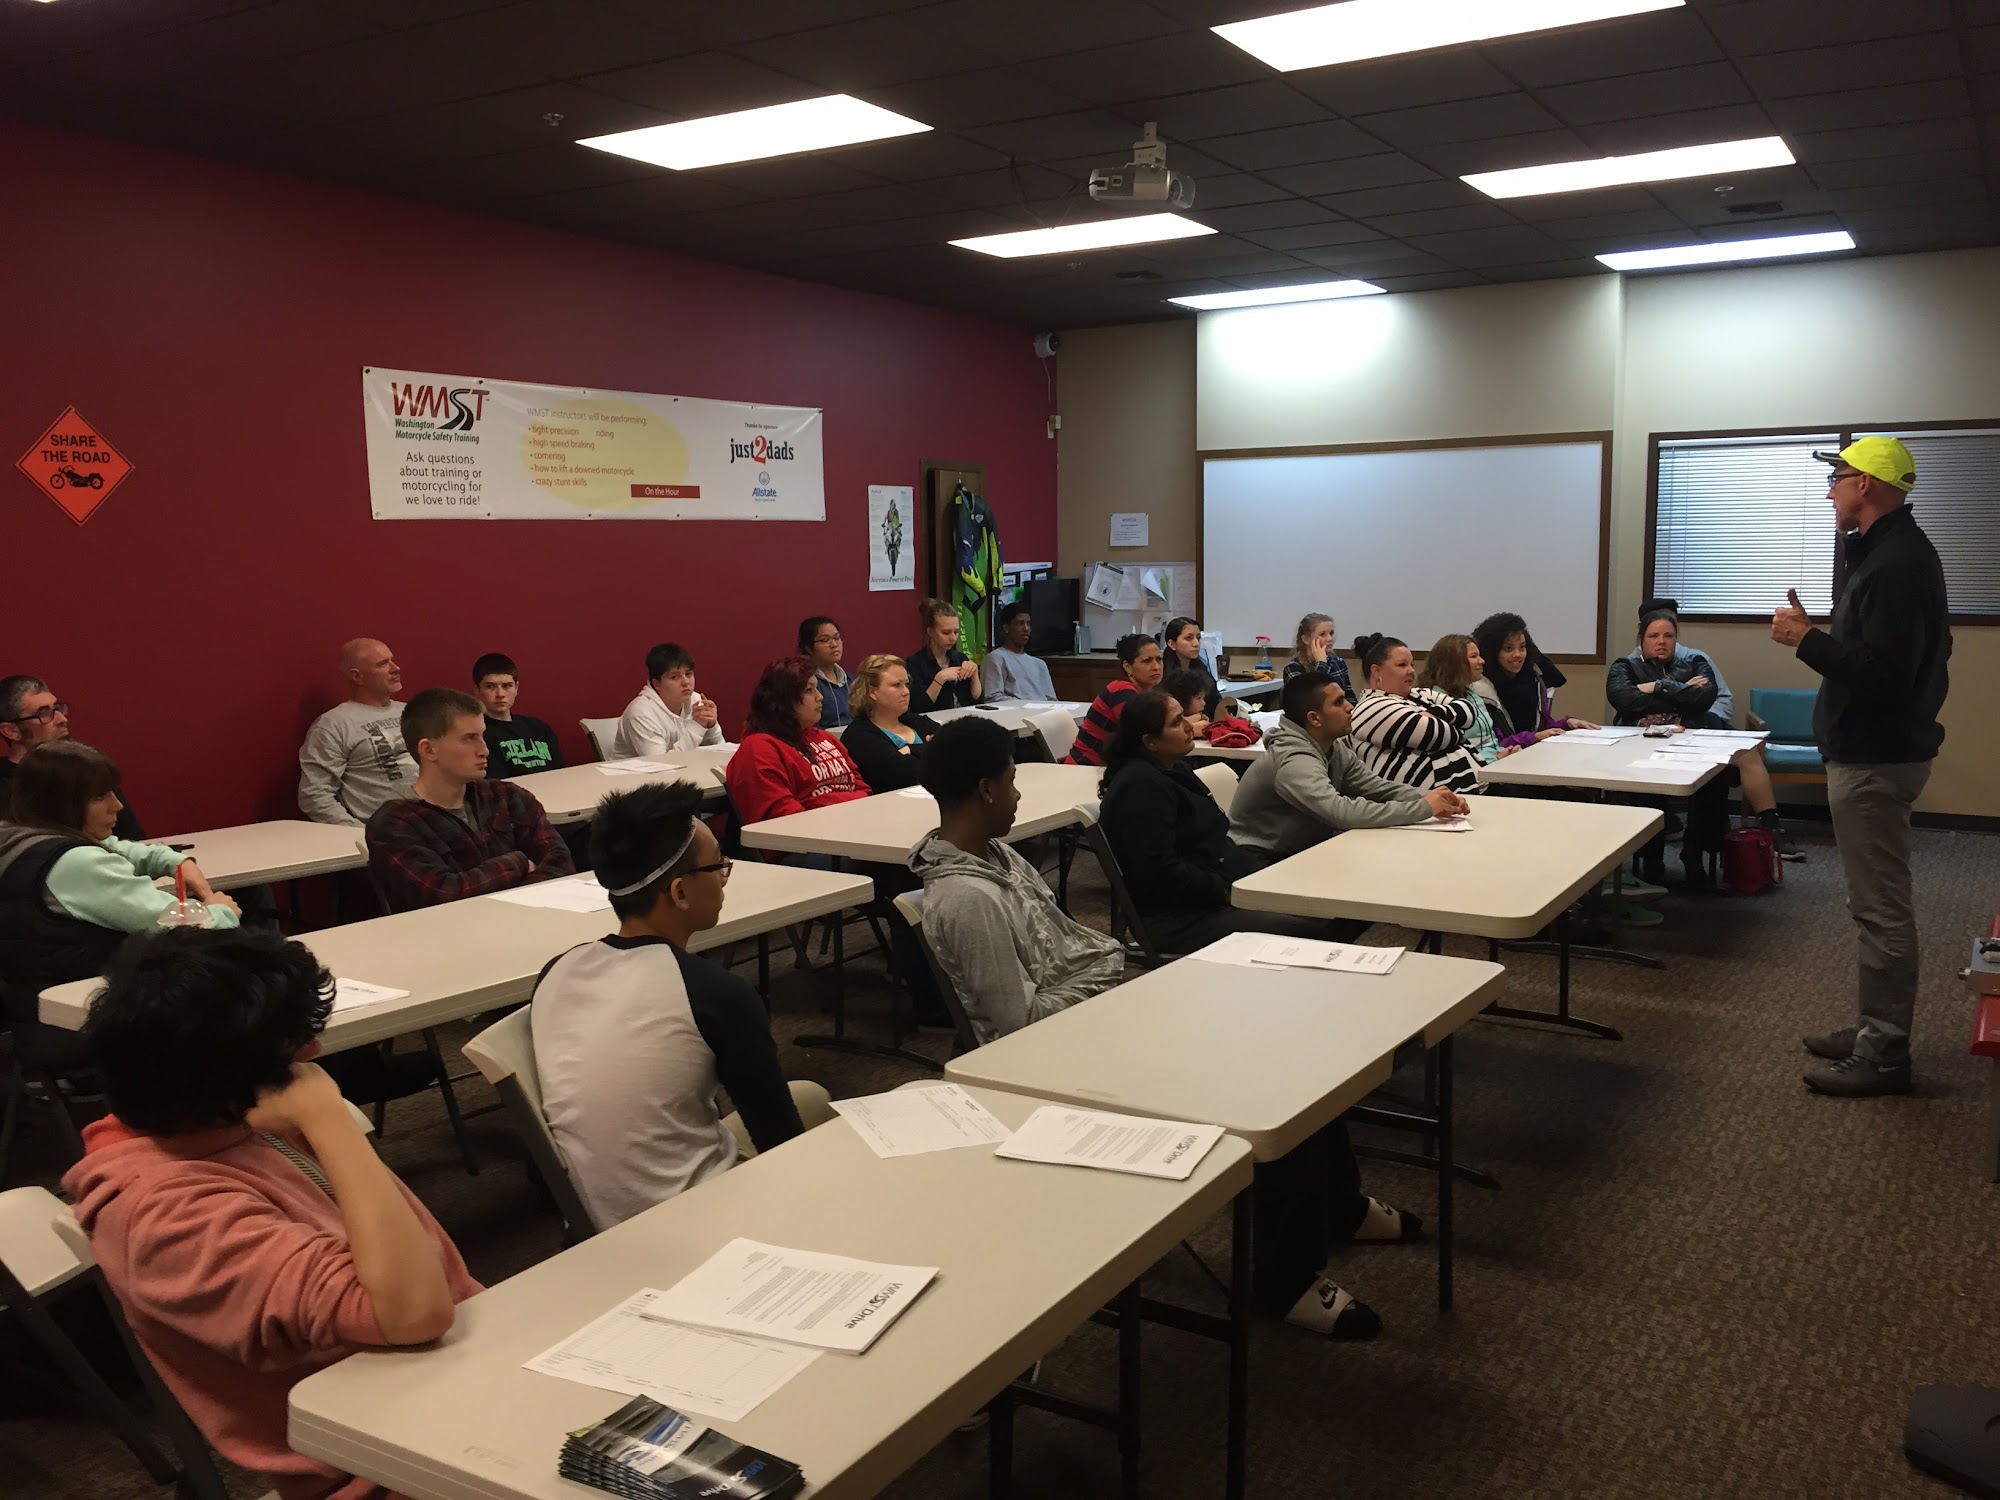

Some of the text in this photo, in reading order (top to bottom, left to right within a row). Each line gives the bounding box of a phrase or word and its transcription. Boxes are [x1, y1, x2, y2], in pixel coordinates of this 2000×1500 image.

[391, 382, 490, 431] WMST
[527, 408, 549, 417] WMST
[551, 410, 586, 421] instructors
[588, 412, 600, 421] will
[601, 412, 609, 422] be
[395, 418, 435, 430] Washington
[532, 426, 548, 435] tight
[549, 427, 579, 436] precision
[50, 434, 97, 447] SHARE
[395, 430, 480, 445] Motorcycle Safety Training
[533, 438, 595, 451] high speed braking
[41, 450, 111, 464] THE ROAD
[730, 435, 794, 465] just2dads
[406, 451, 475, 465] Ask questions
[399, 465, 482, 480] about training or
[534, 464, 550, 473] how
[559, 465, 568, 473] lift
[574, 466, 601, 474] downed
[601, 467, 635, 476] motorcycle
[401, 480, 482, 494] motorcycling for
[535, 478, 587, 487] crazy stunt skills
[644, 486, 680, 497] On the Hour
[752, 487, 777, 498] Allstate
[405, 493, 481, 506] we love to ride!
[844, 1282, 904, 1329] WMST Drive
[698, 1460, 768, 1497] WMS Drive
